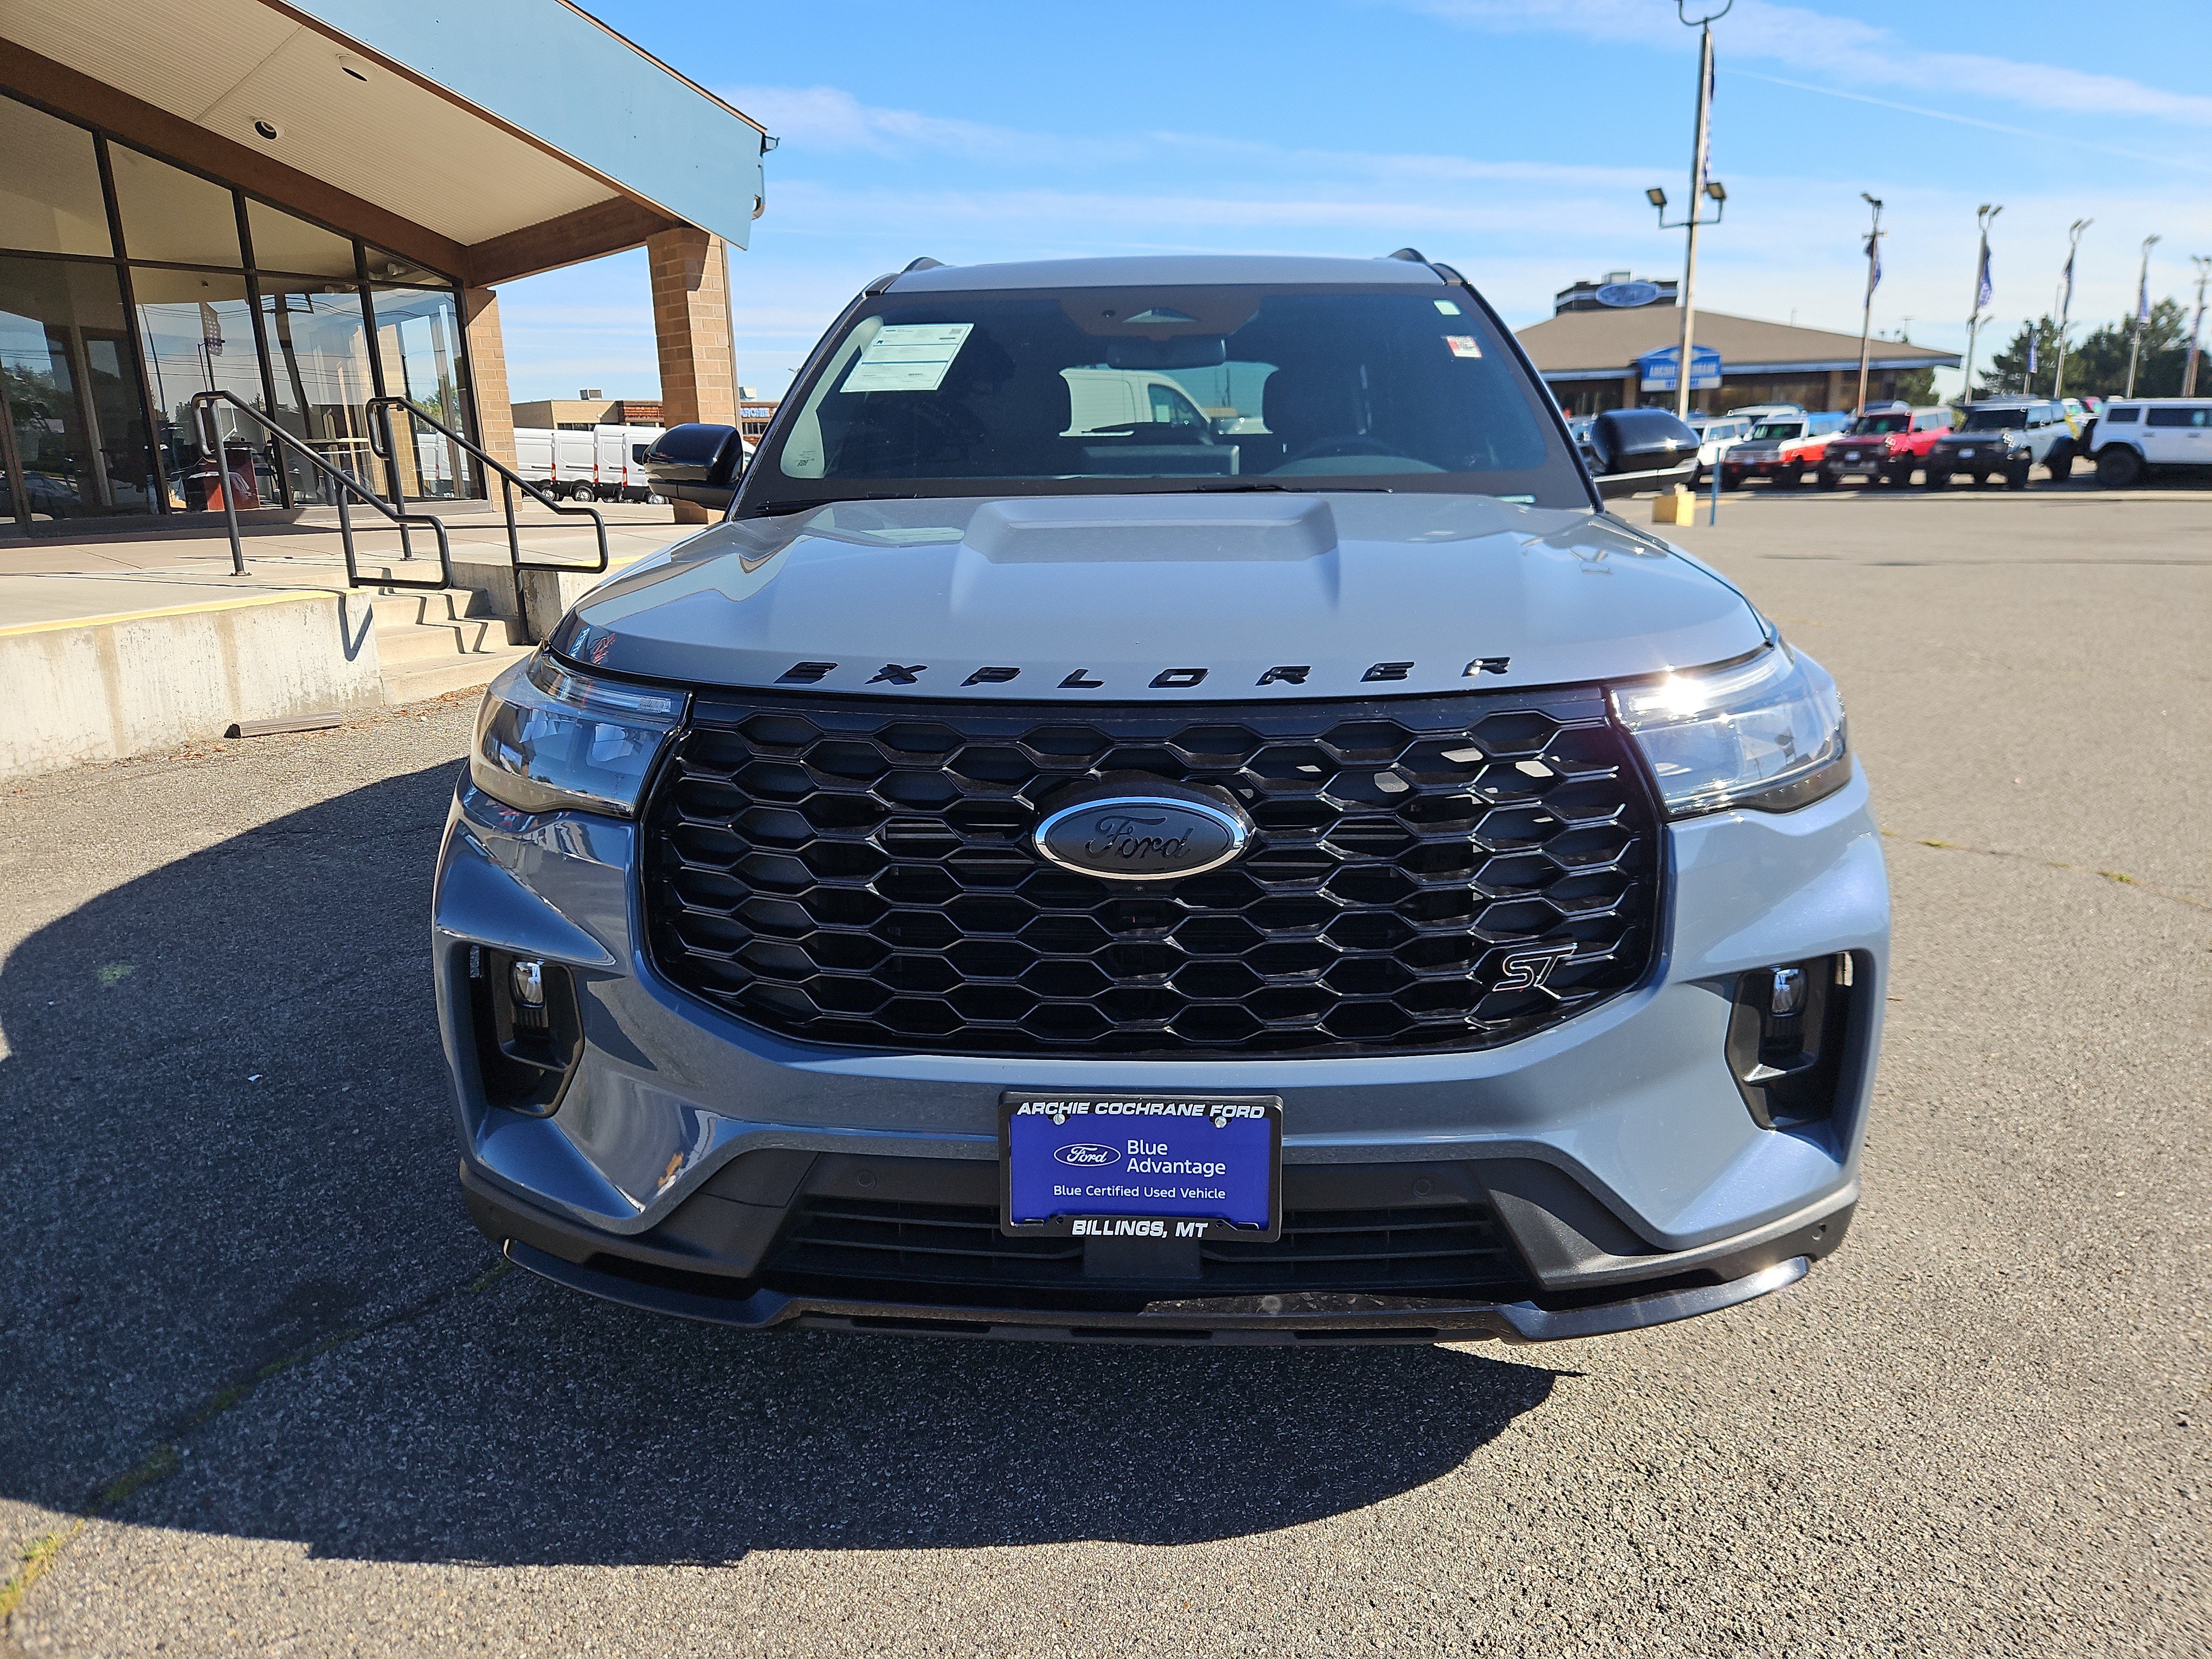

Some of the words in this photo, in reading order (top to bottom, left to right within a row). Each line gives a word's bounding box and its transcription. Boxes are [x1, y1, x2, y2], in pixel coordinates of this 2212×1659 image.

[774, 657, 1511, 689] EXPLORER
[1085, 815, 1194, 859] Ford
[1492, 942, 1578, 992] ST
[1017, 1102, 1090, 1116] ARCHIE
[1095, 1103, 1205, 1117] COCHRANE
[1210, 1104, 1265, 1119] FORD
[1066, 1146, 1107, 1163] Ford
[1127, 1139, 1168, 1156] Blue
[1126, 1158, 1226, 1178] Advantage
[1053, 1185, 1082, 1196] Blue
[1086, 1185, 1139, 1197] Certified
[1144, 1187, 1176, 1198] Used
[1180, 1187, 1226, 1199] Vehicle
[1071, 1219, 1168, 1238] BILLINGS,
[1175, 1221, 1208, 1238] MT
